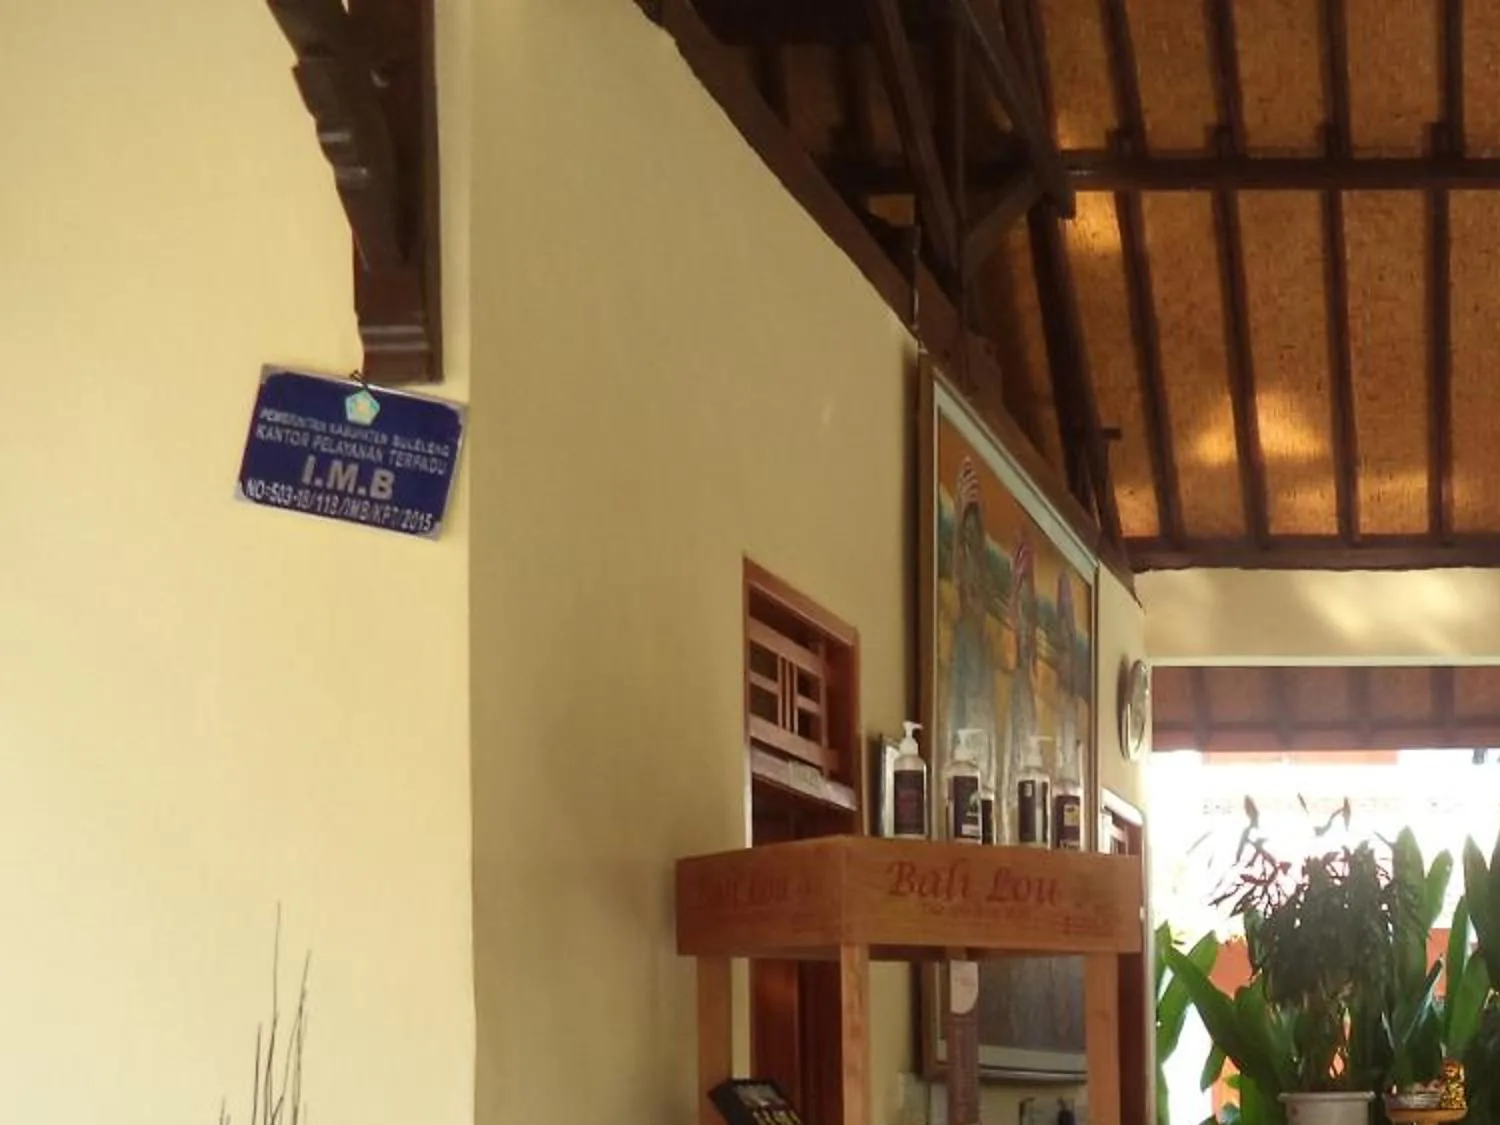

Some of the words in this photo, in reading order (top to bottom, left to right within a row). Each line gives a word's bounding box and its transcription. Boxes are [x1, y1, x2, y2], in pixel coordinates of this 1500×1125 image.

[255, 423, 310, 448] KANTOR
[311, 434, 384, 464] PELAYANAN
[387, 449, 448, 476] TERPADU
[886, 856, 969, 902] Bali
